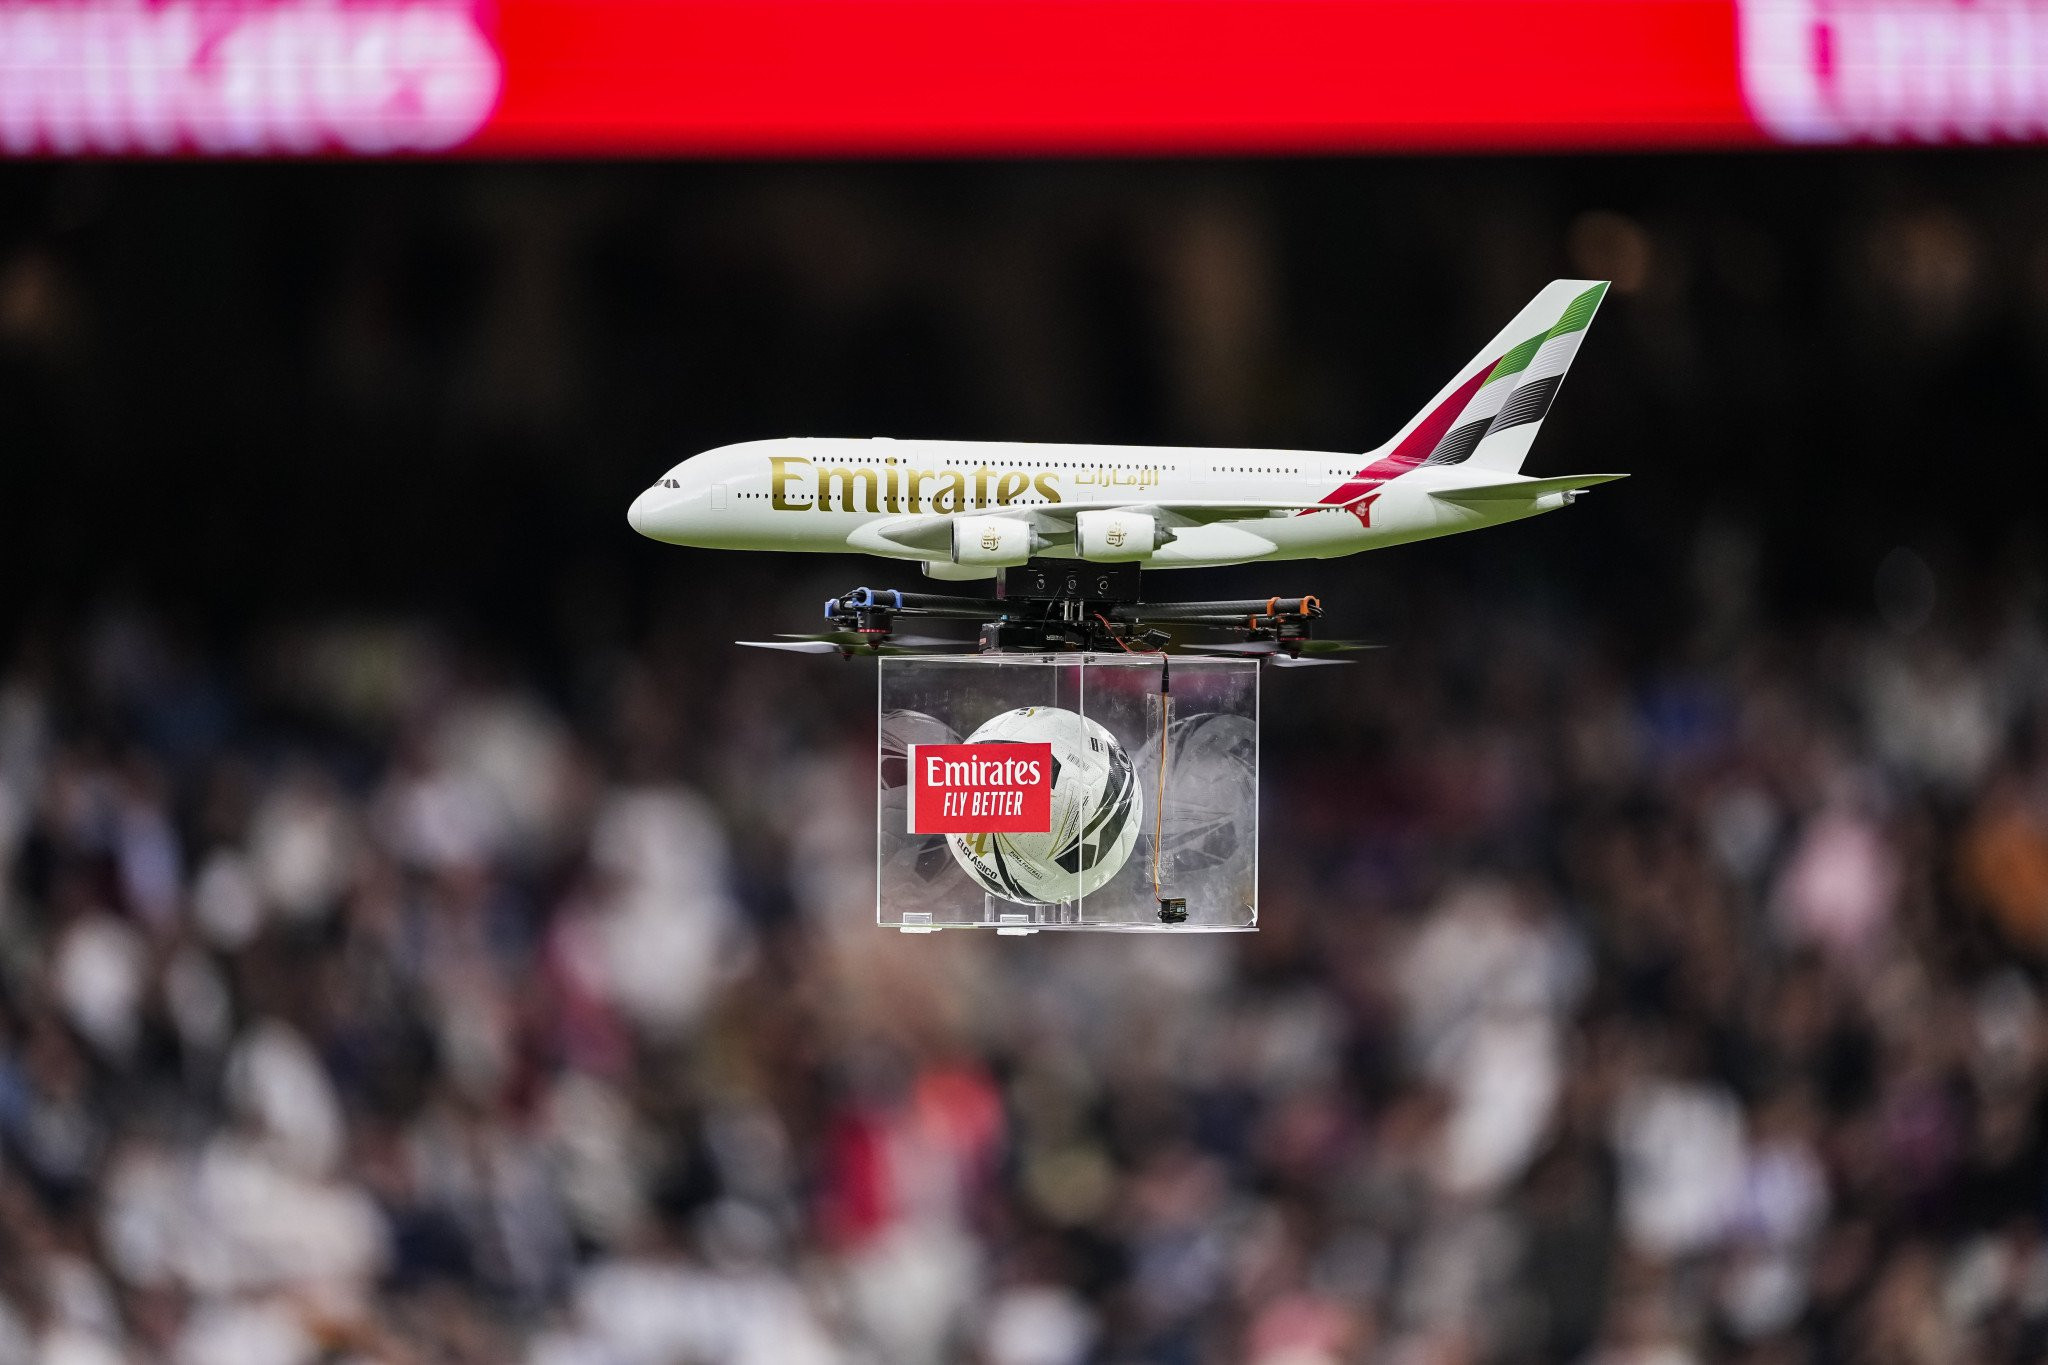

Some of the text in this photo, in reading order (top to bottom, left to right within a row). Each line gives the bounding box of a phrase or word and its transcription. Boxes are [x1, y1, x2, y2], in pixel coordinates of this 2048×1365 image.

[768, 455, 1062, 515] Emirates
[1075, 468, 1159, 491] الإمارات
[926, 754, 1041, 787] Emirates
[943, 791, 1024, 817] FLY BETTER
